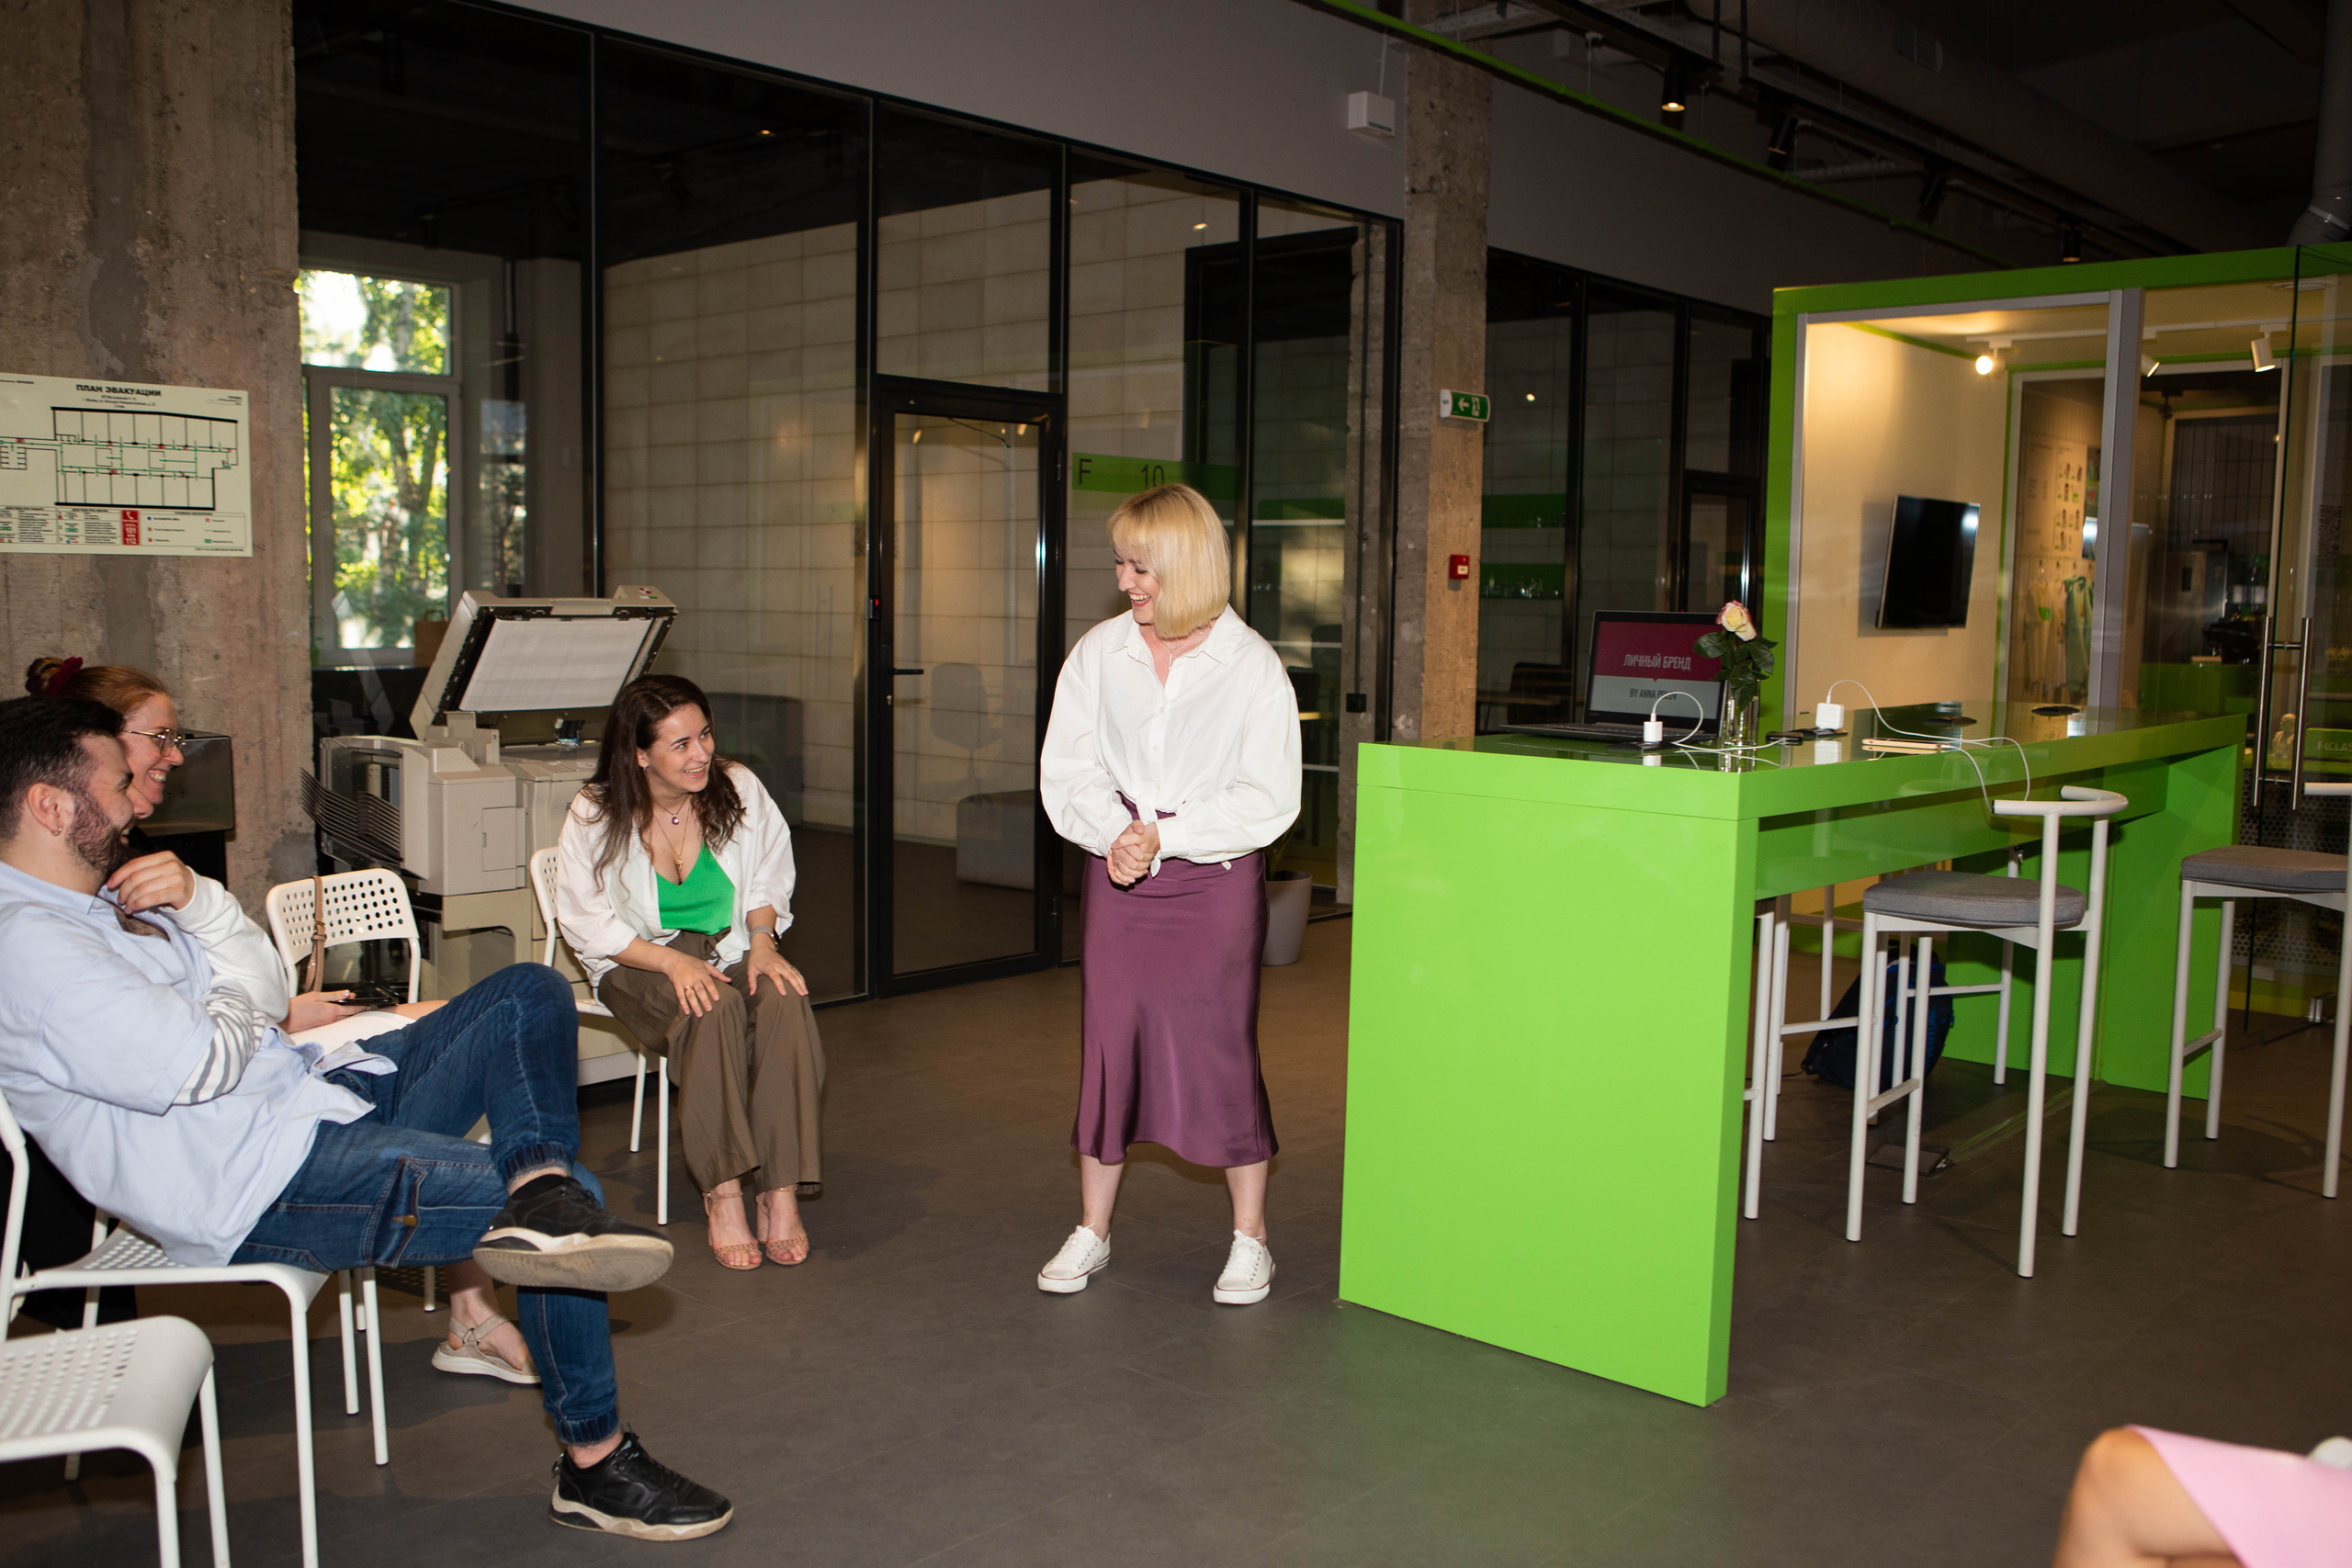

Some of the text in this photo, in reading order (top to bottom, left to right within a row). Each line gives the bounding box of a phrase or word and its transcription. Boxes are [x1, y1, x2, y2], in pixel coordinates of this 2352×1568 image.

[76, 384, 162, 397] ПЛАН ЭВАКУАЦИИ
[1079, 458, 1165, 490] F 10
[1623, 653, 1691, 671] ЛИЧНЫЙ БРЕНД
[1629, 688, 1638, 698] BY
[1639, 689, 1657, 699] ANNA
